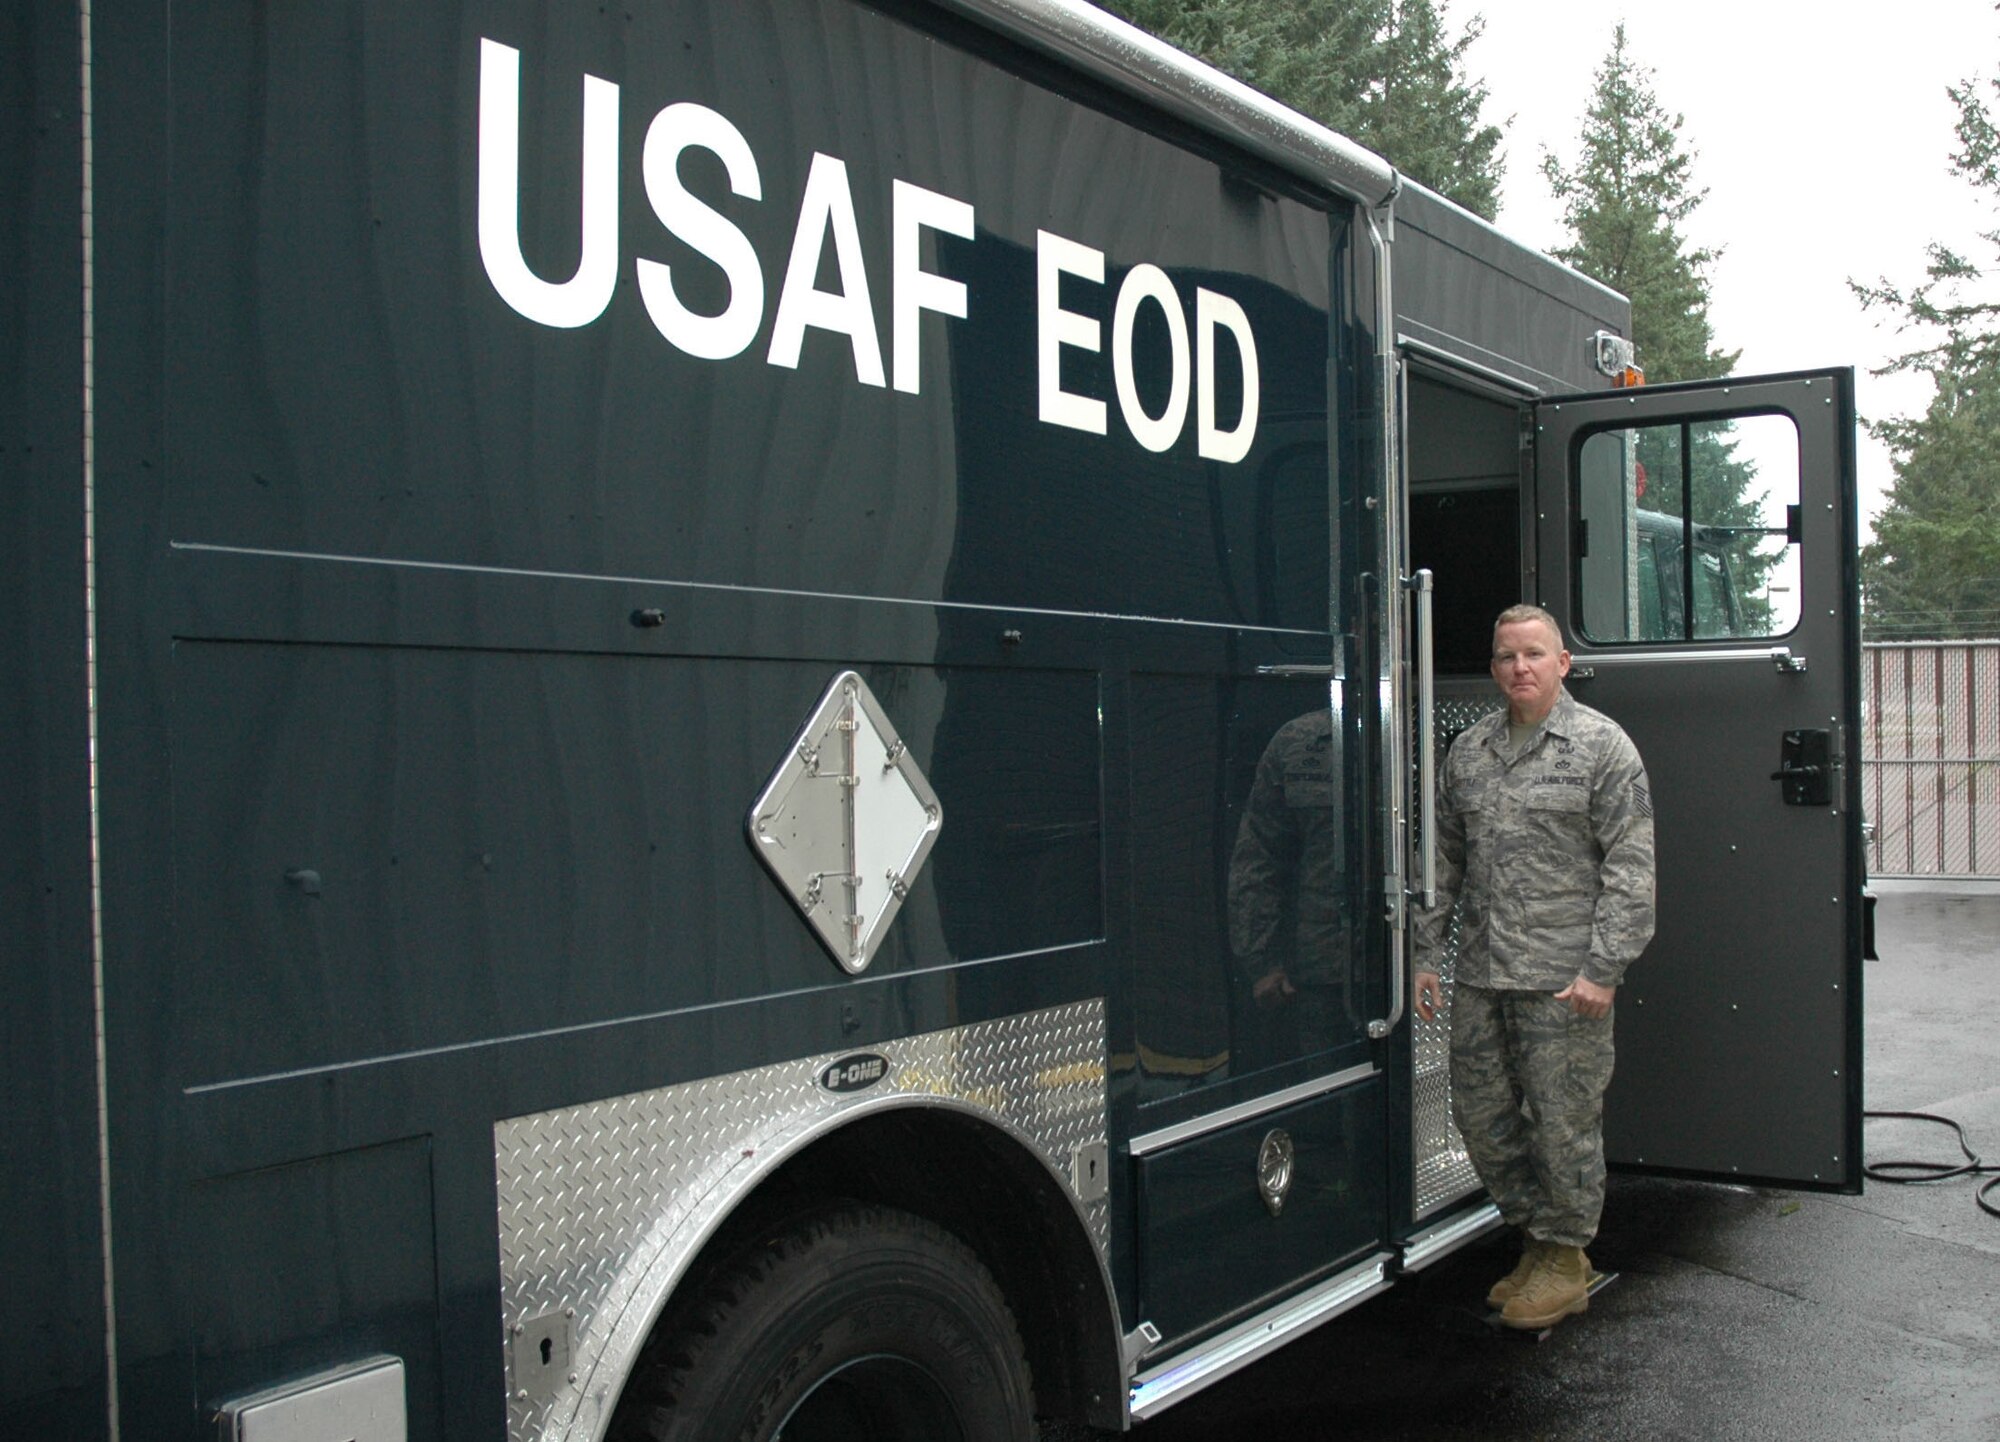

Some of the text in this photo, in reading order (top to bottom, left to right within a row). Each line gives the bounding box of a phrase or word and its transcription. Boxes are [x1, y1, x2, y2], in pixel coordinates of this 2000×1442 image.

[478, 37, 1260, 464] USAF EOD
[828, 1059, 882, 1088] E-ONE
